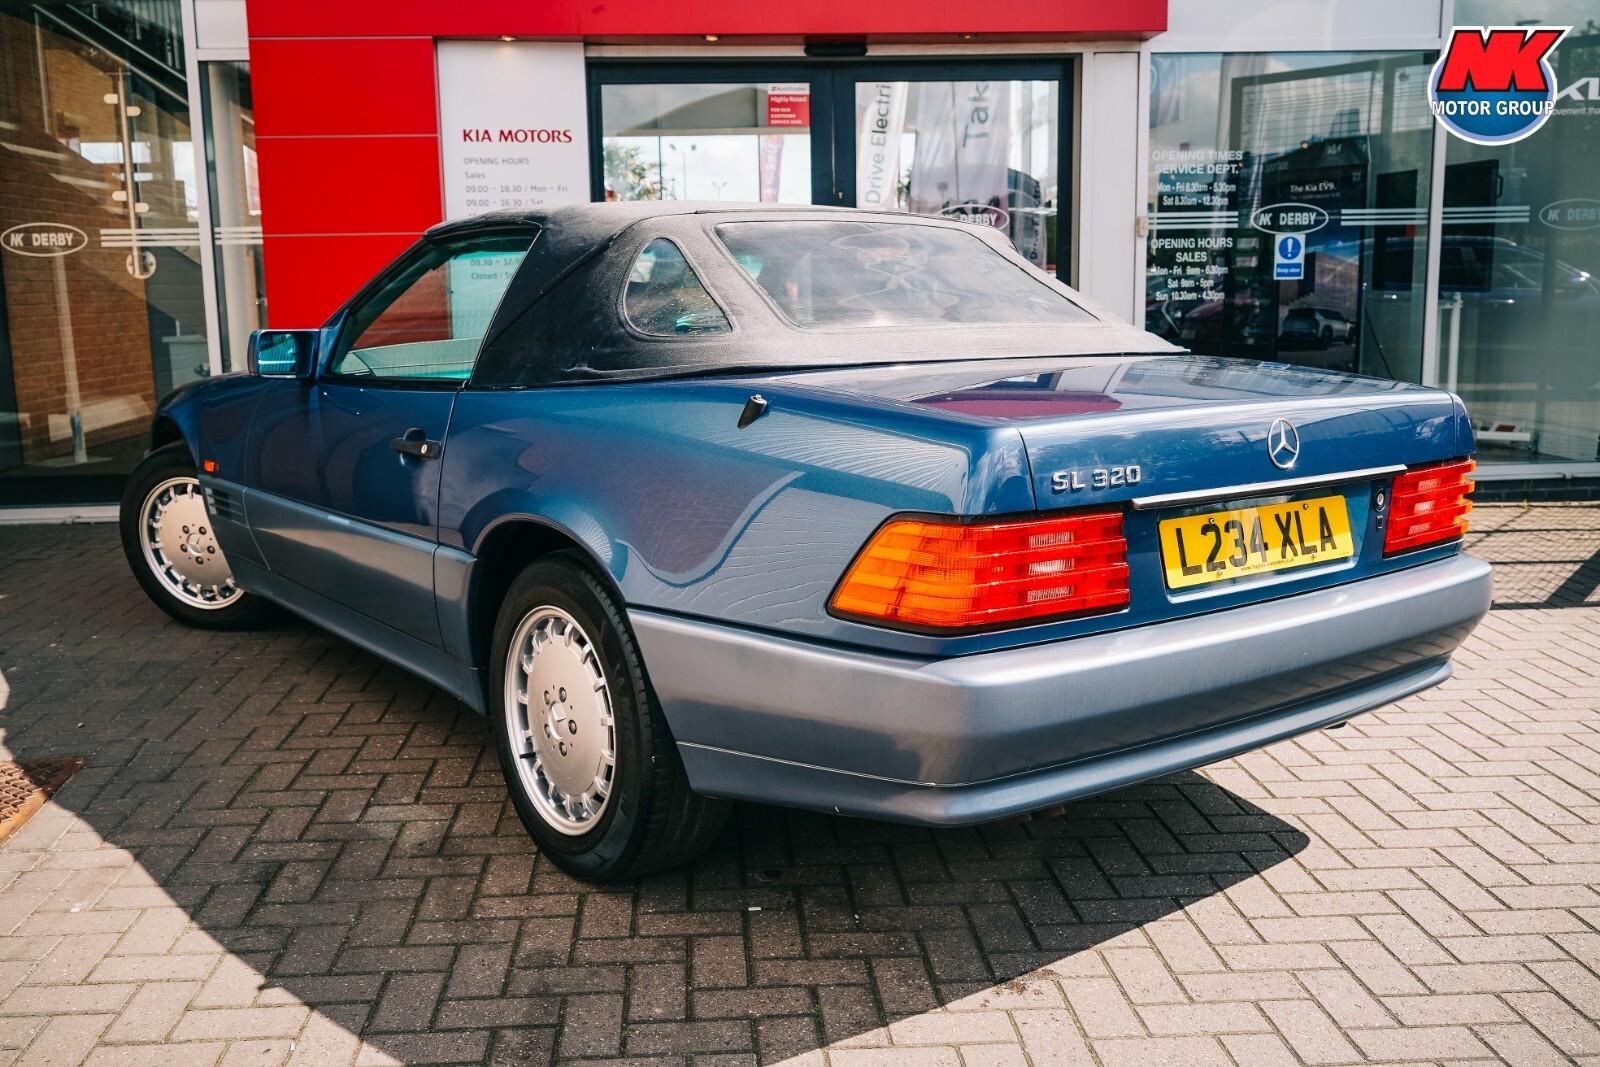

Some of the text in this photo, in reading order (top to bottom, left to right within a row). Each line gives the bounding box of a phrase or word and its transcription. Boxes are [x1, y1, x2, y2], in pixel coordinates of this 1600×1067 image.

[1551, 107, 1586, 116] ovement
[463, 129, 572, 143] KIA MOTORS
[463, 157, 530, 165] OPENING HOURS
[1152, 150, 1243, 161] OPENING TIMES
[1155, 163, 1239, 174] SERVICE DEPT.
[464, 171, 486, 179] Sales
[865, 152, 886, 204] Drive
[530, 184, 547, 192] Mon
[557, 184, 568, 192] Fri
[1176, 182, 1185, 192] Fri
[1290, 184, 1304, 193] The
[1304, 183, 1318, 192] Kia
[1163, 195, 1174, 206] Sat
[960, 213, 998, 226] DERBY
[1279, 212, 1317, 225] DERBY
[1567, 207, 1600, 221] DERBY
[32, 232, 74, 247] DERBY
[1151, 237, 1233, 249] OPENING HOURS
[1175, 251, 1208, 262] SALES
[471, 272, 498, 280] Closed
[1173, 266, 1182, 275] Fri
[1167, 278, 1178, 288] Sat
[1155, 291, 1168, 301] Sun
[1052, 465, 1141, 491] SL 320
[1175, 506, 1338, 577] L234 XLA
